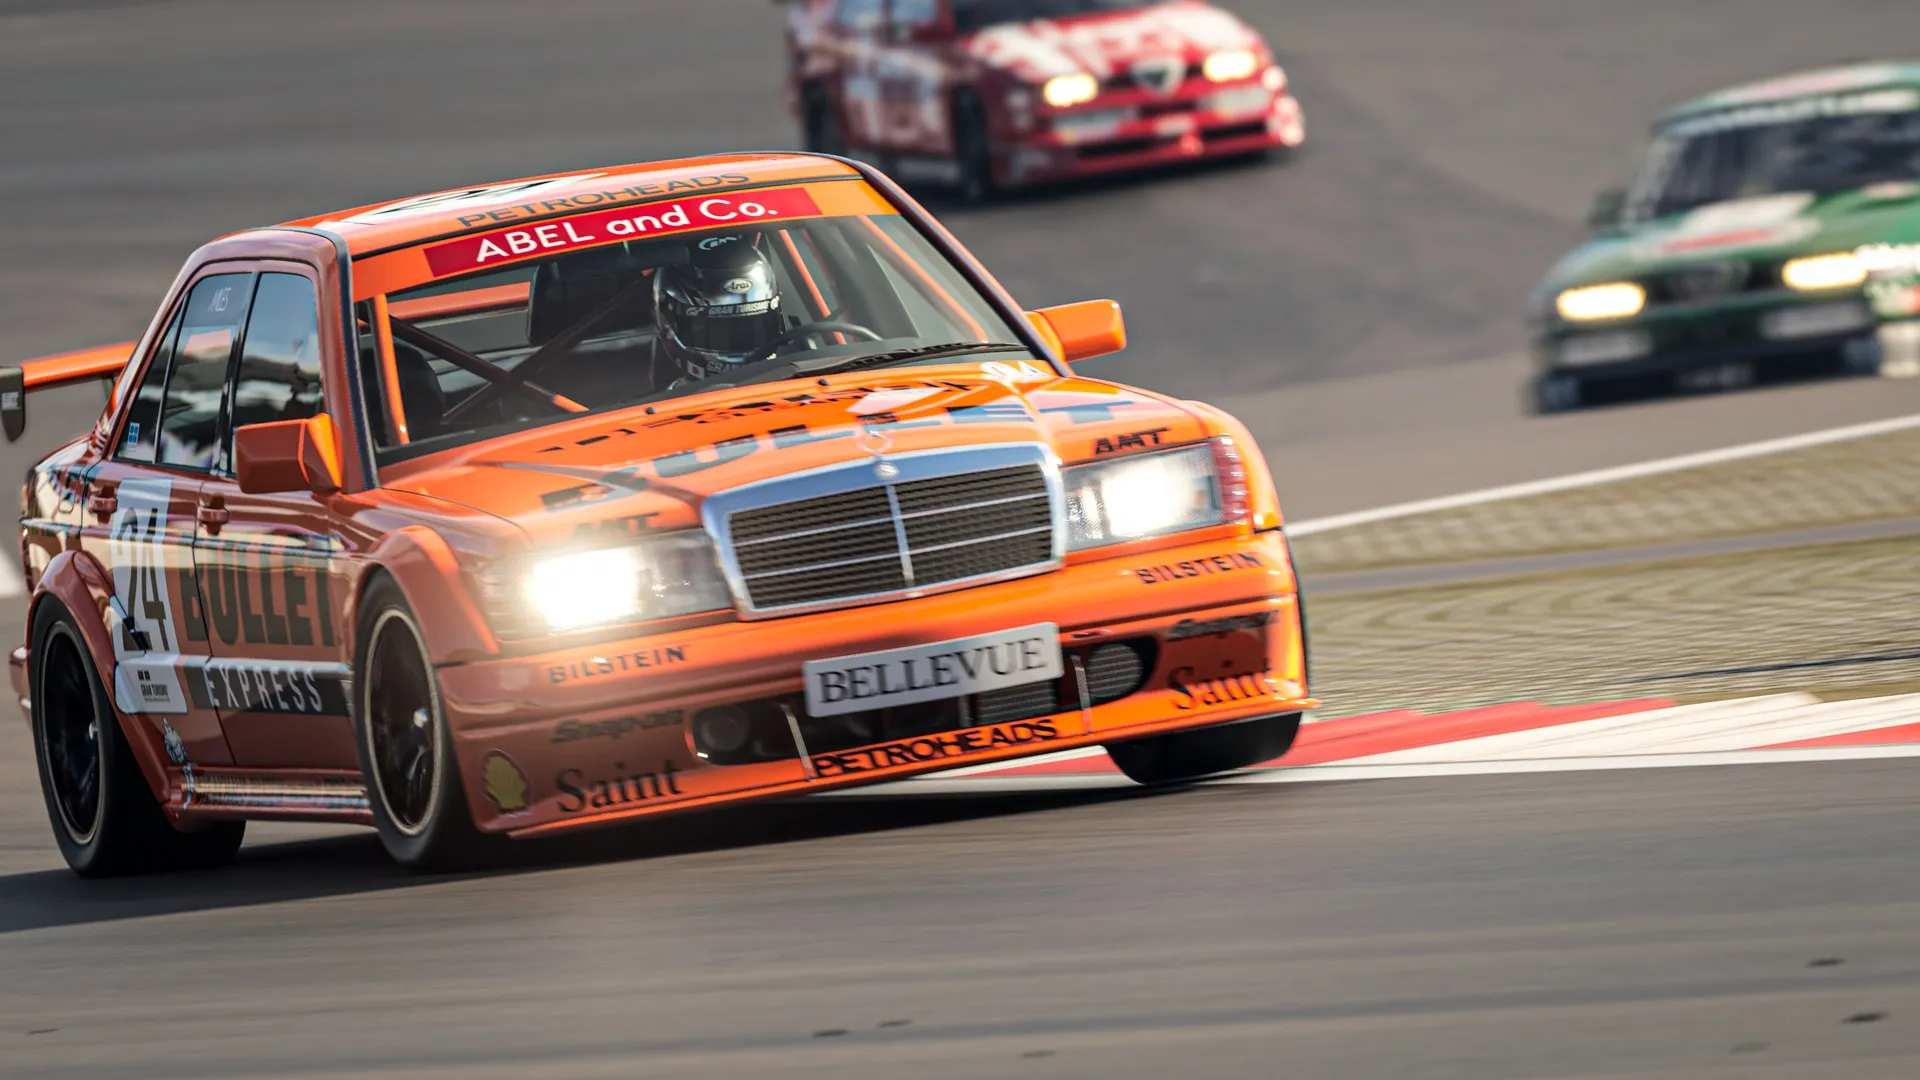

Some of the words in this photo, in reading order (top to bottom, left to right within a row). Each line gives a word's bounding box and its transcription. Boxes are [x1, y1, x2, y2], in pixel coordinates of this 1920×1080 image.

[455, 172, 751, 228] PETROHEADS
[476, 222, 596, 263] ABEL
[606, 204, 691, 235] and
[699, 198, 779, 221] Co.
[1094, 427, 1168, 455] AMT
[117, 507, 170, 651] 24
[177, 535, 338, 647] BULLET
[1136, 552, 1265, 584] BILSTEIN
[203, 664, 323, 712] EXPRESS
[549, 645, 689, 684] BILSTEIN
[817, 637, 1048, 704] BELLEVUE
[813, 719, 1058, 778] PETROHEADS
[556, 759, 684, 813] Saint
